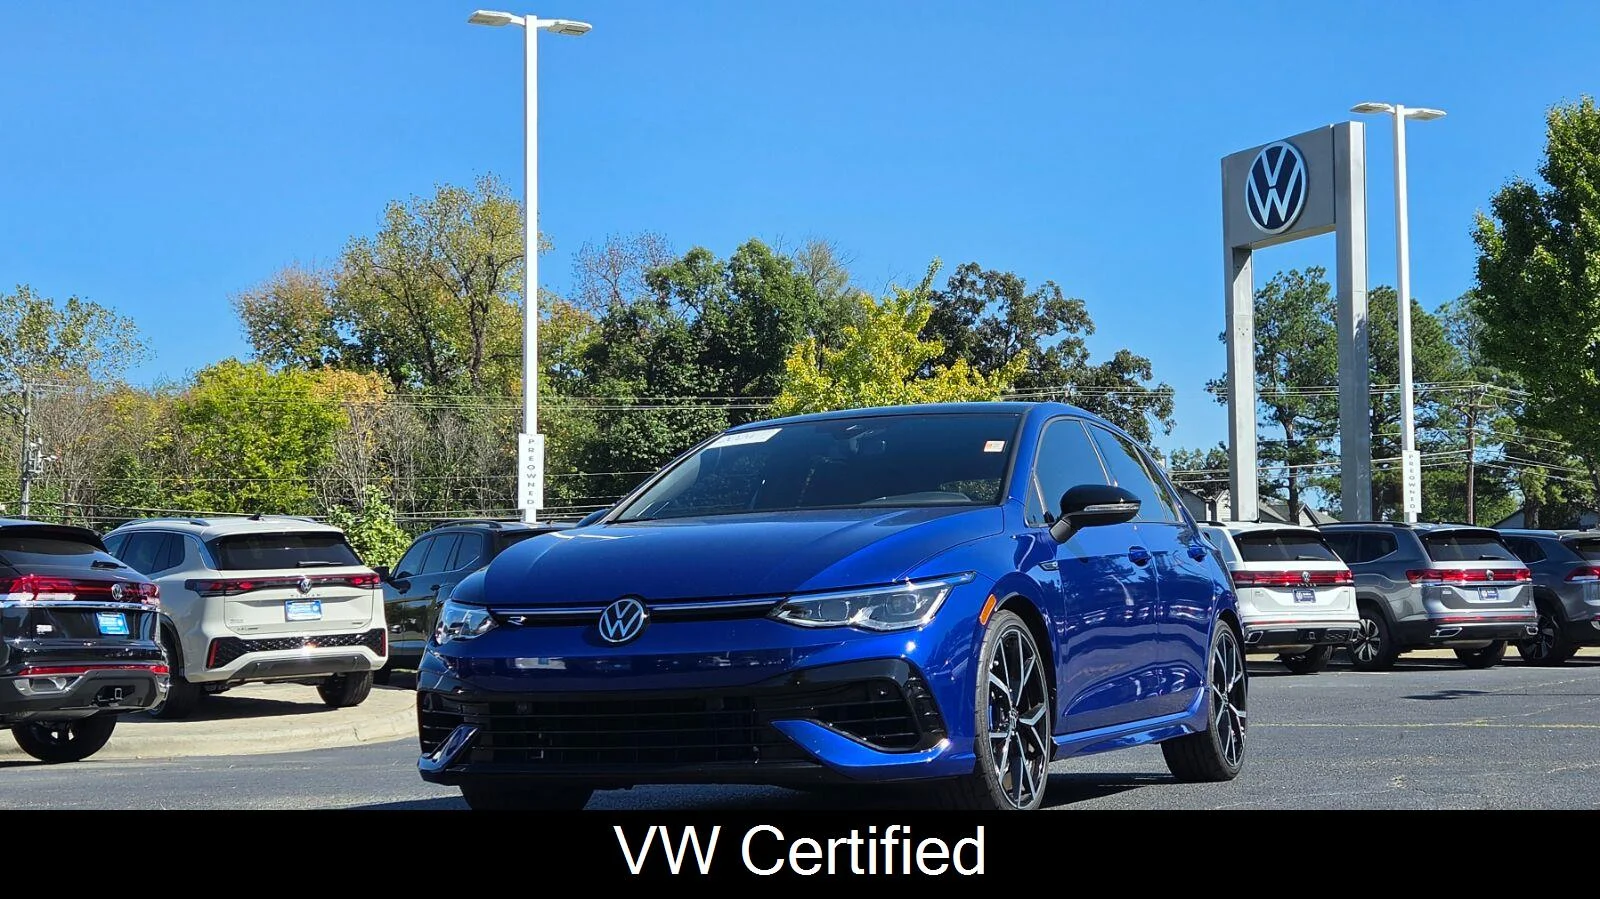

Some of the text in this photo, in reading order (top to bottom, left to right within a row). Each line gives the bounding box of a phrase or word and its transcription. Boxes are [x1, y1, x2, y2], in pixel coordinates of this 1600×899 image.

[1249, 144, 1303, 227] VW
[526, 438, 537, 505] PREOWNED
[603, 600, 643, 639] VW
